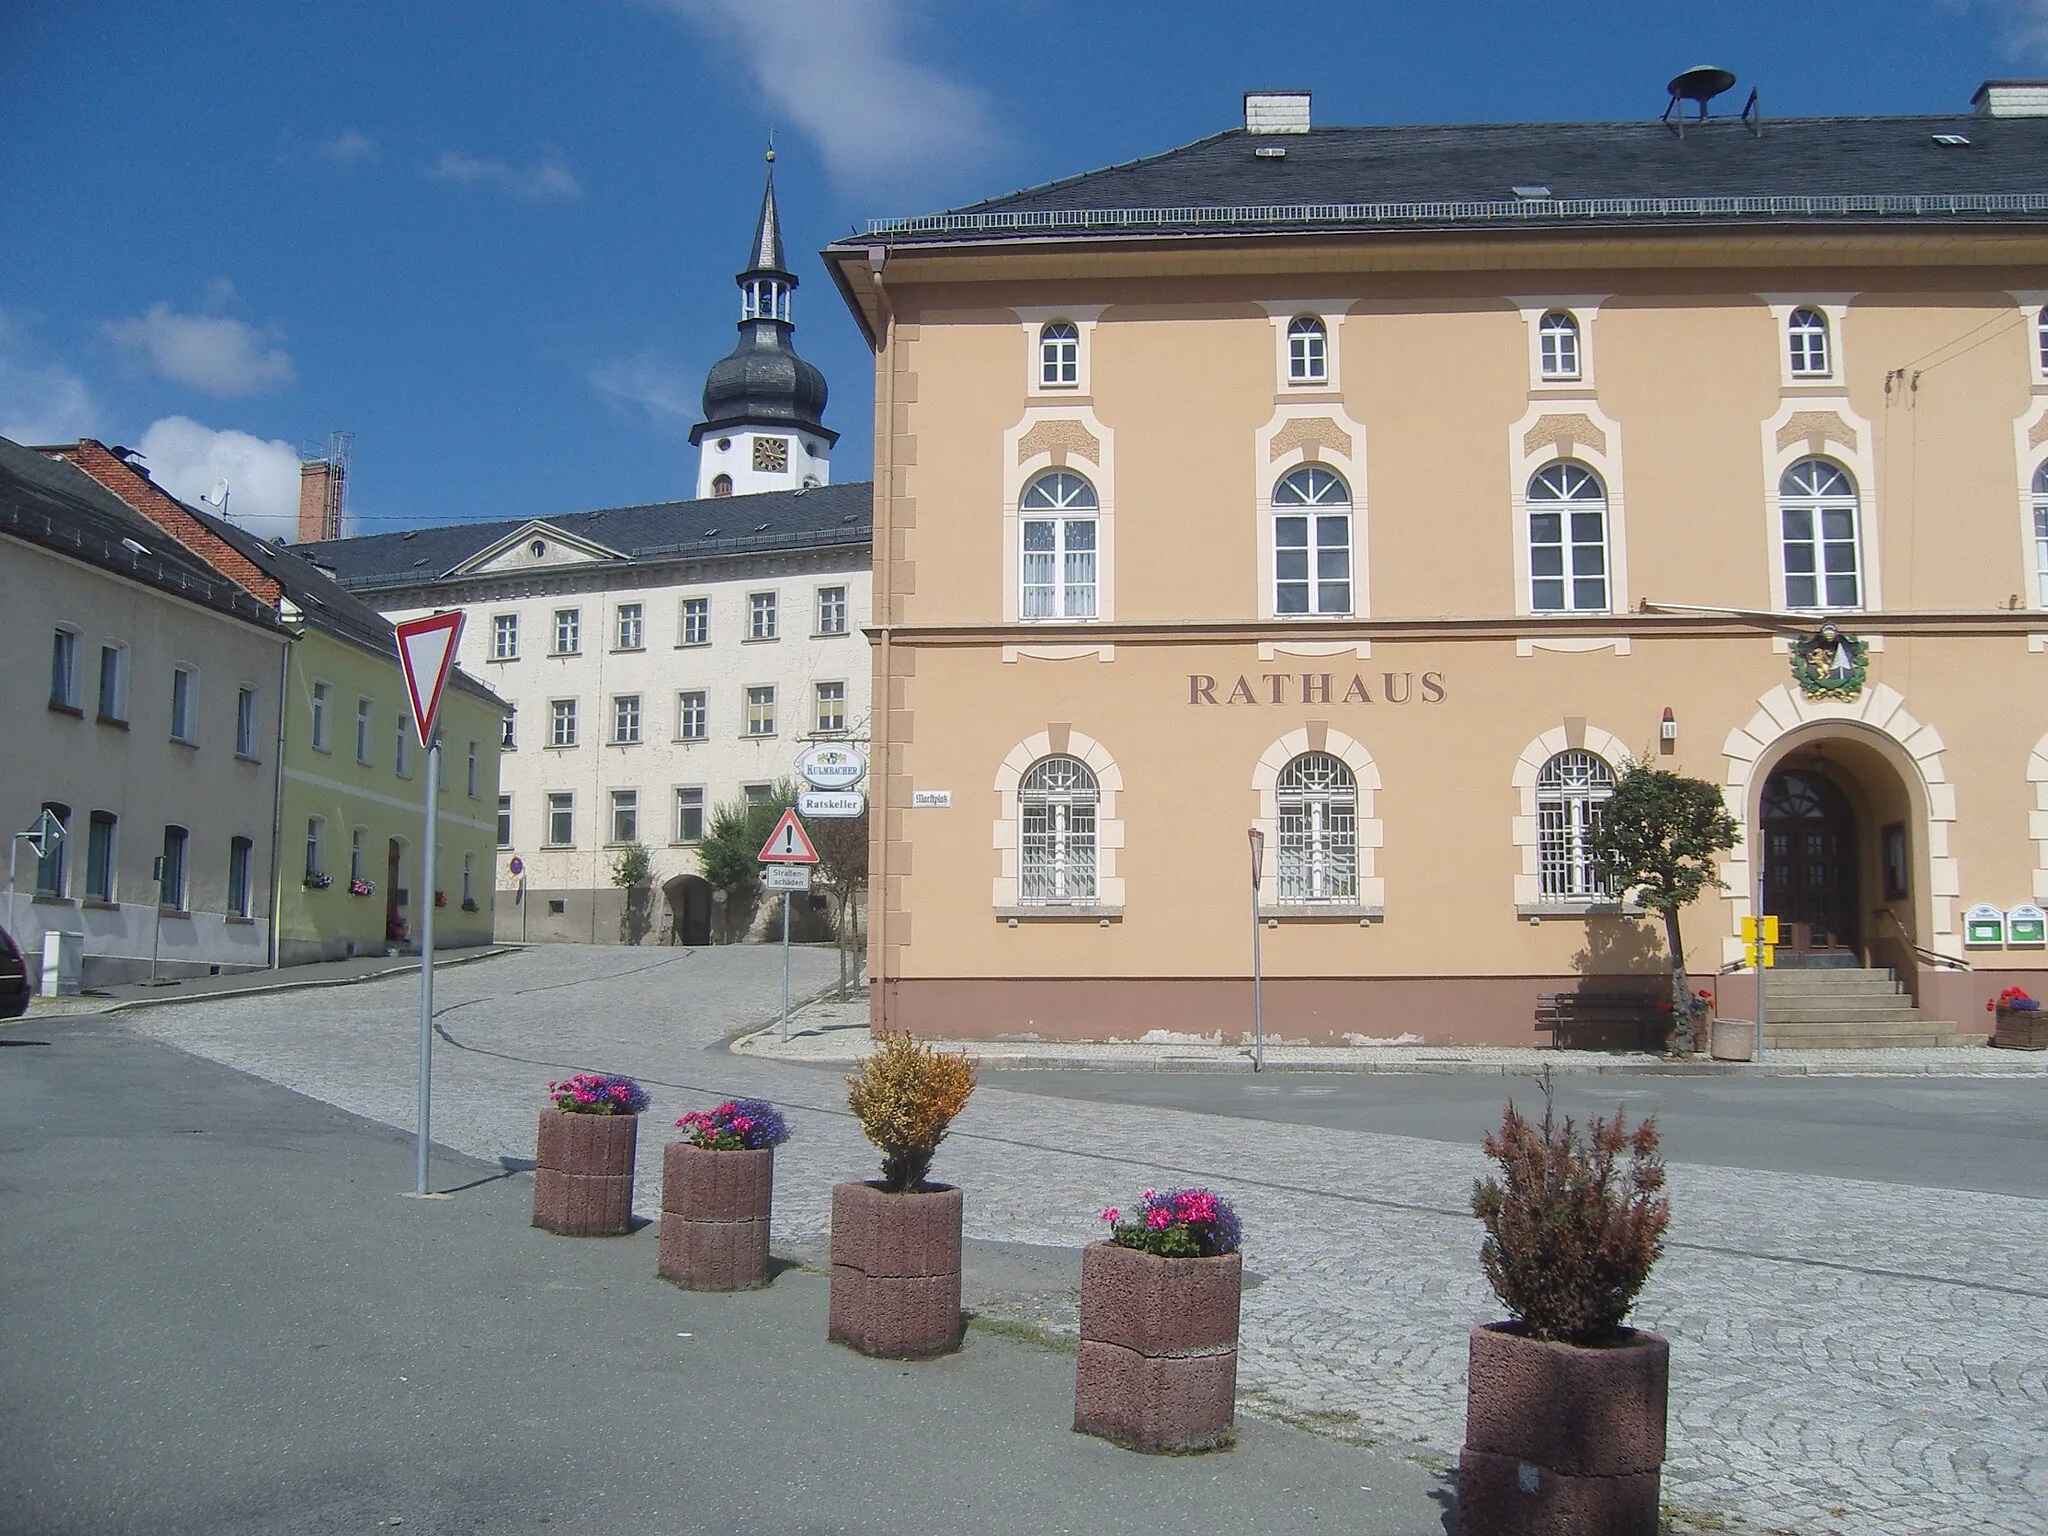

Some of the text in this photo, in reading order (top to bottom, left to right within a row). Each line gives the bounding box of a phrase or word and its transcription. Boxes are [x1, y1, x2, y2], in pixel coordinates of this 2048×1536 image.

[1187, 671, 1446, 705] RATHAUS
[806, 764, 858, 776] KULMBACHER
[806, 799, 858, 809] Ratskeller
[773, 868, 805, 877] Straßen-
